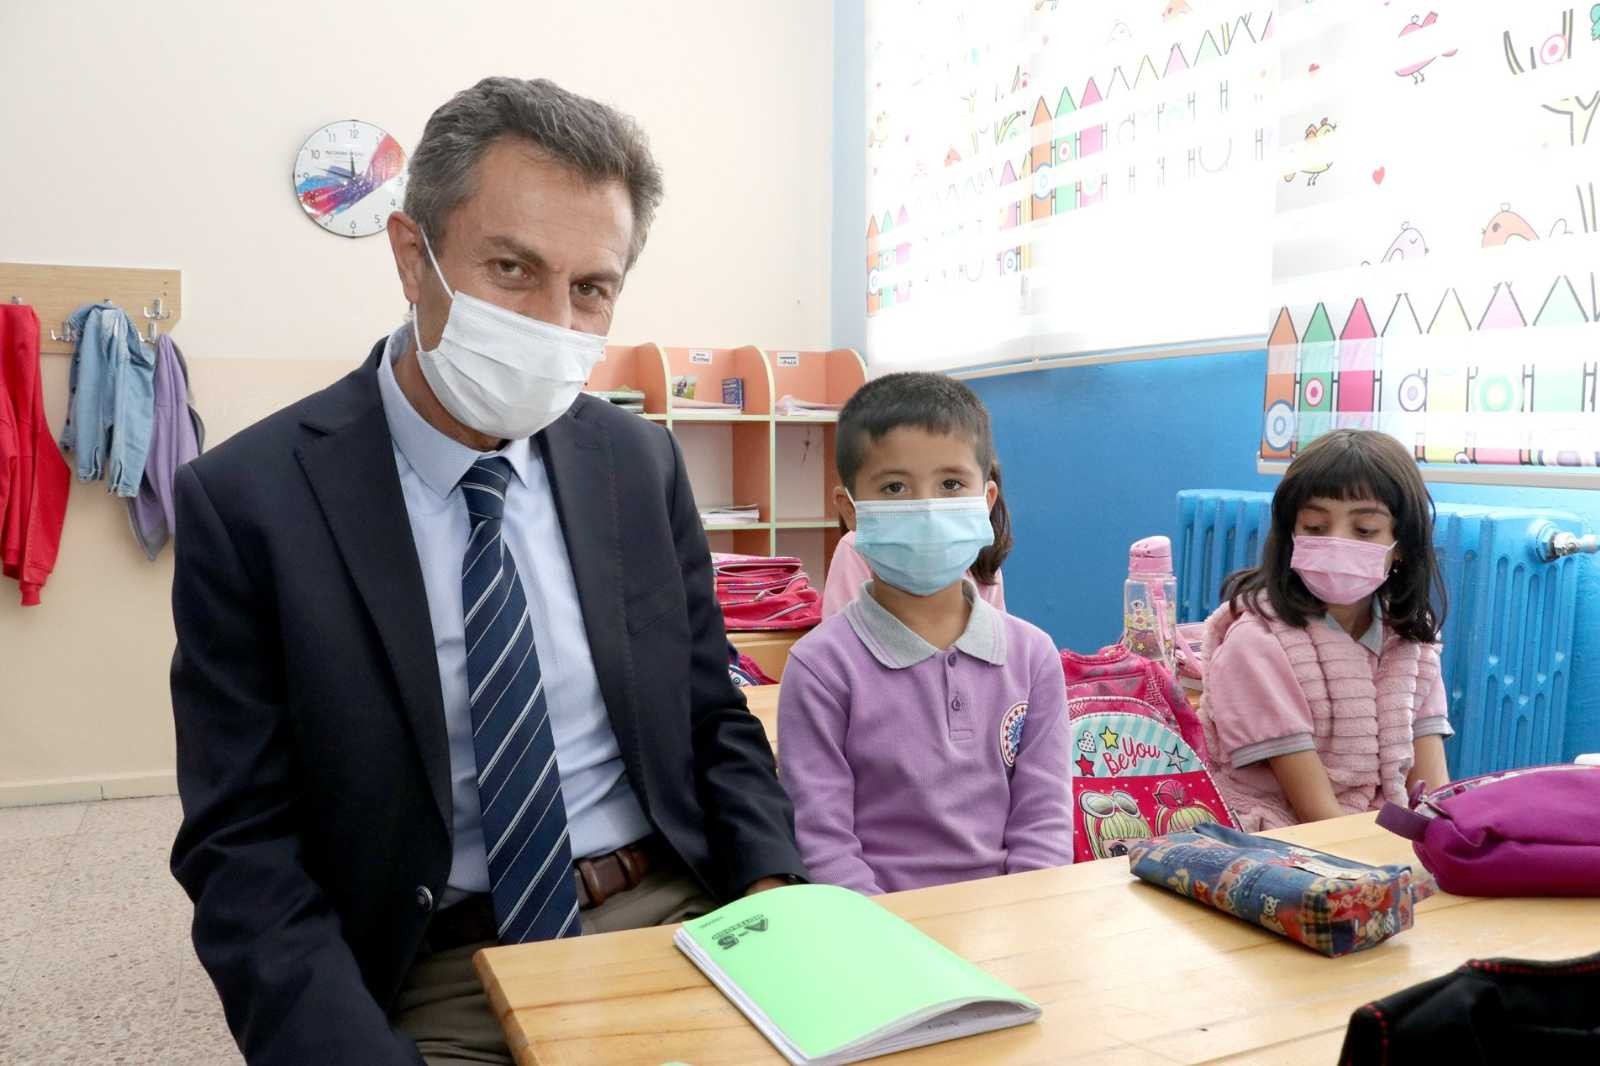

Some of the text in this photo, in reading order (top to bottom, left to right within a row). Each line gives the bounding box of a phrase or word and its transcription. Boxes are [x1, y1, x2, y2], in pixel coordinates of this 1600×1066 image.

[328, 133, 336, 142] 11
[350, 129, 359, 139] 12
[311, 149, 320, 160] 10
[304, 172, 310, 180] 9
[390, 198, 396, 207] 4
[374, 214, 381, 224] 5
[350, 220, 357, 229] 6
[1102, 736, 1160, 776] Be You
